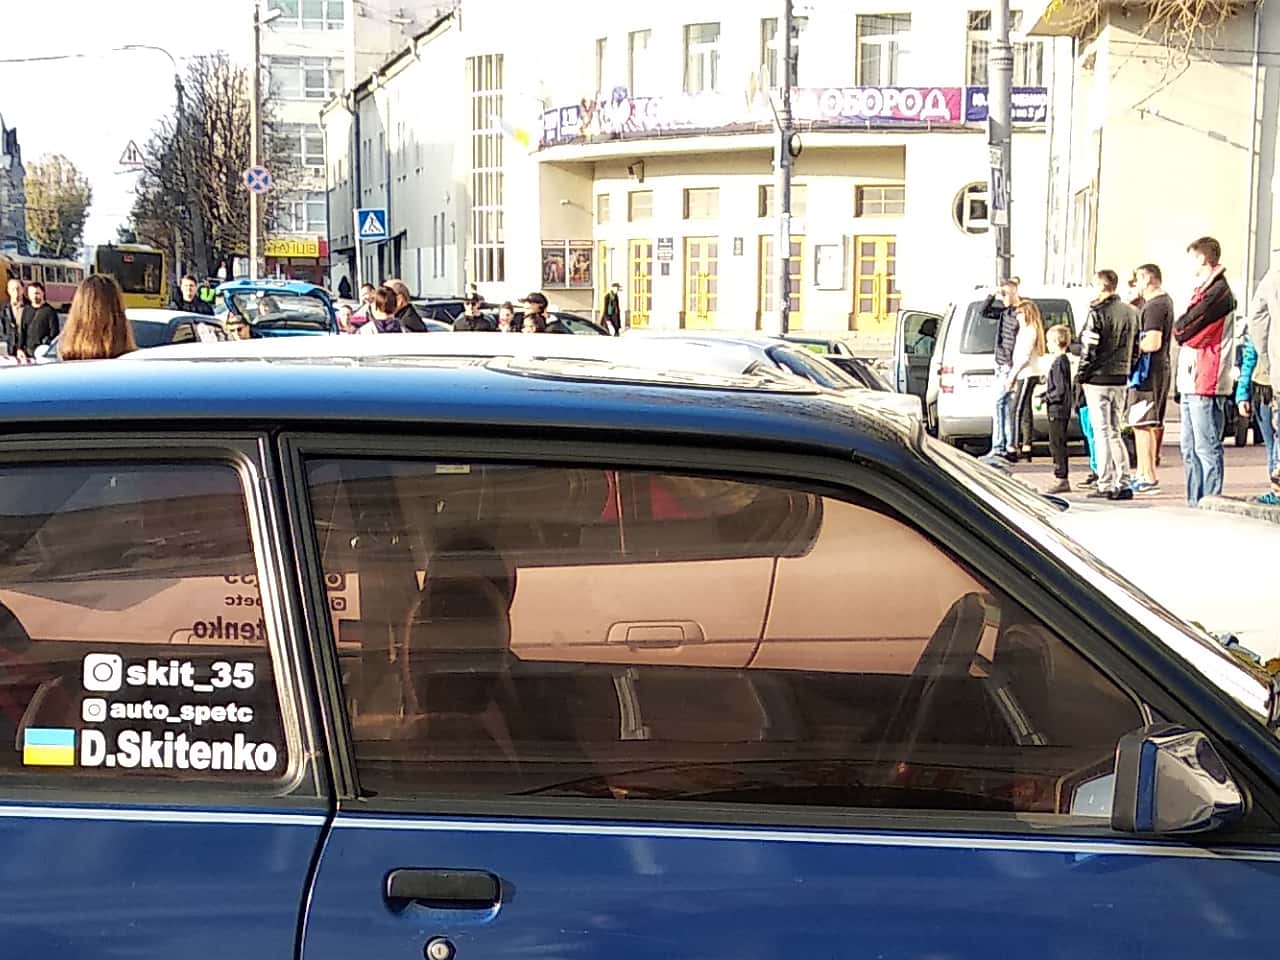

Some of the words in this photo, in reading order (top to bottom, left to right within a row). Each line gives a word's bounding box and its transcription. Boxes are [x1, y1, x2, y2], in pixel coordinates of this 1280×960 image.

[817, 88, 951, 121] ОБОРОД
[126, 659, 255, 692] skit_35
[109, 700, 254, 725] auto_spetc
[81, 729, 277, 771] D.Skitenko
